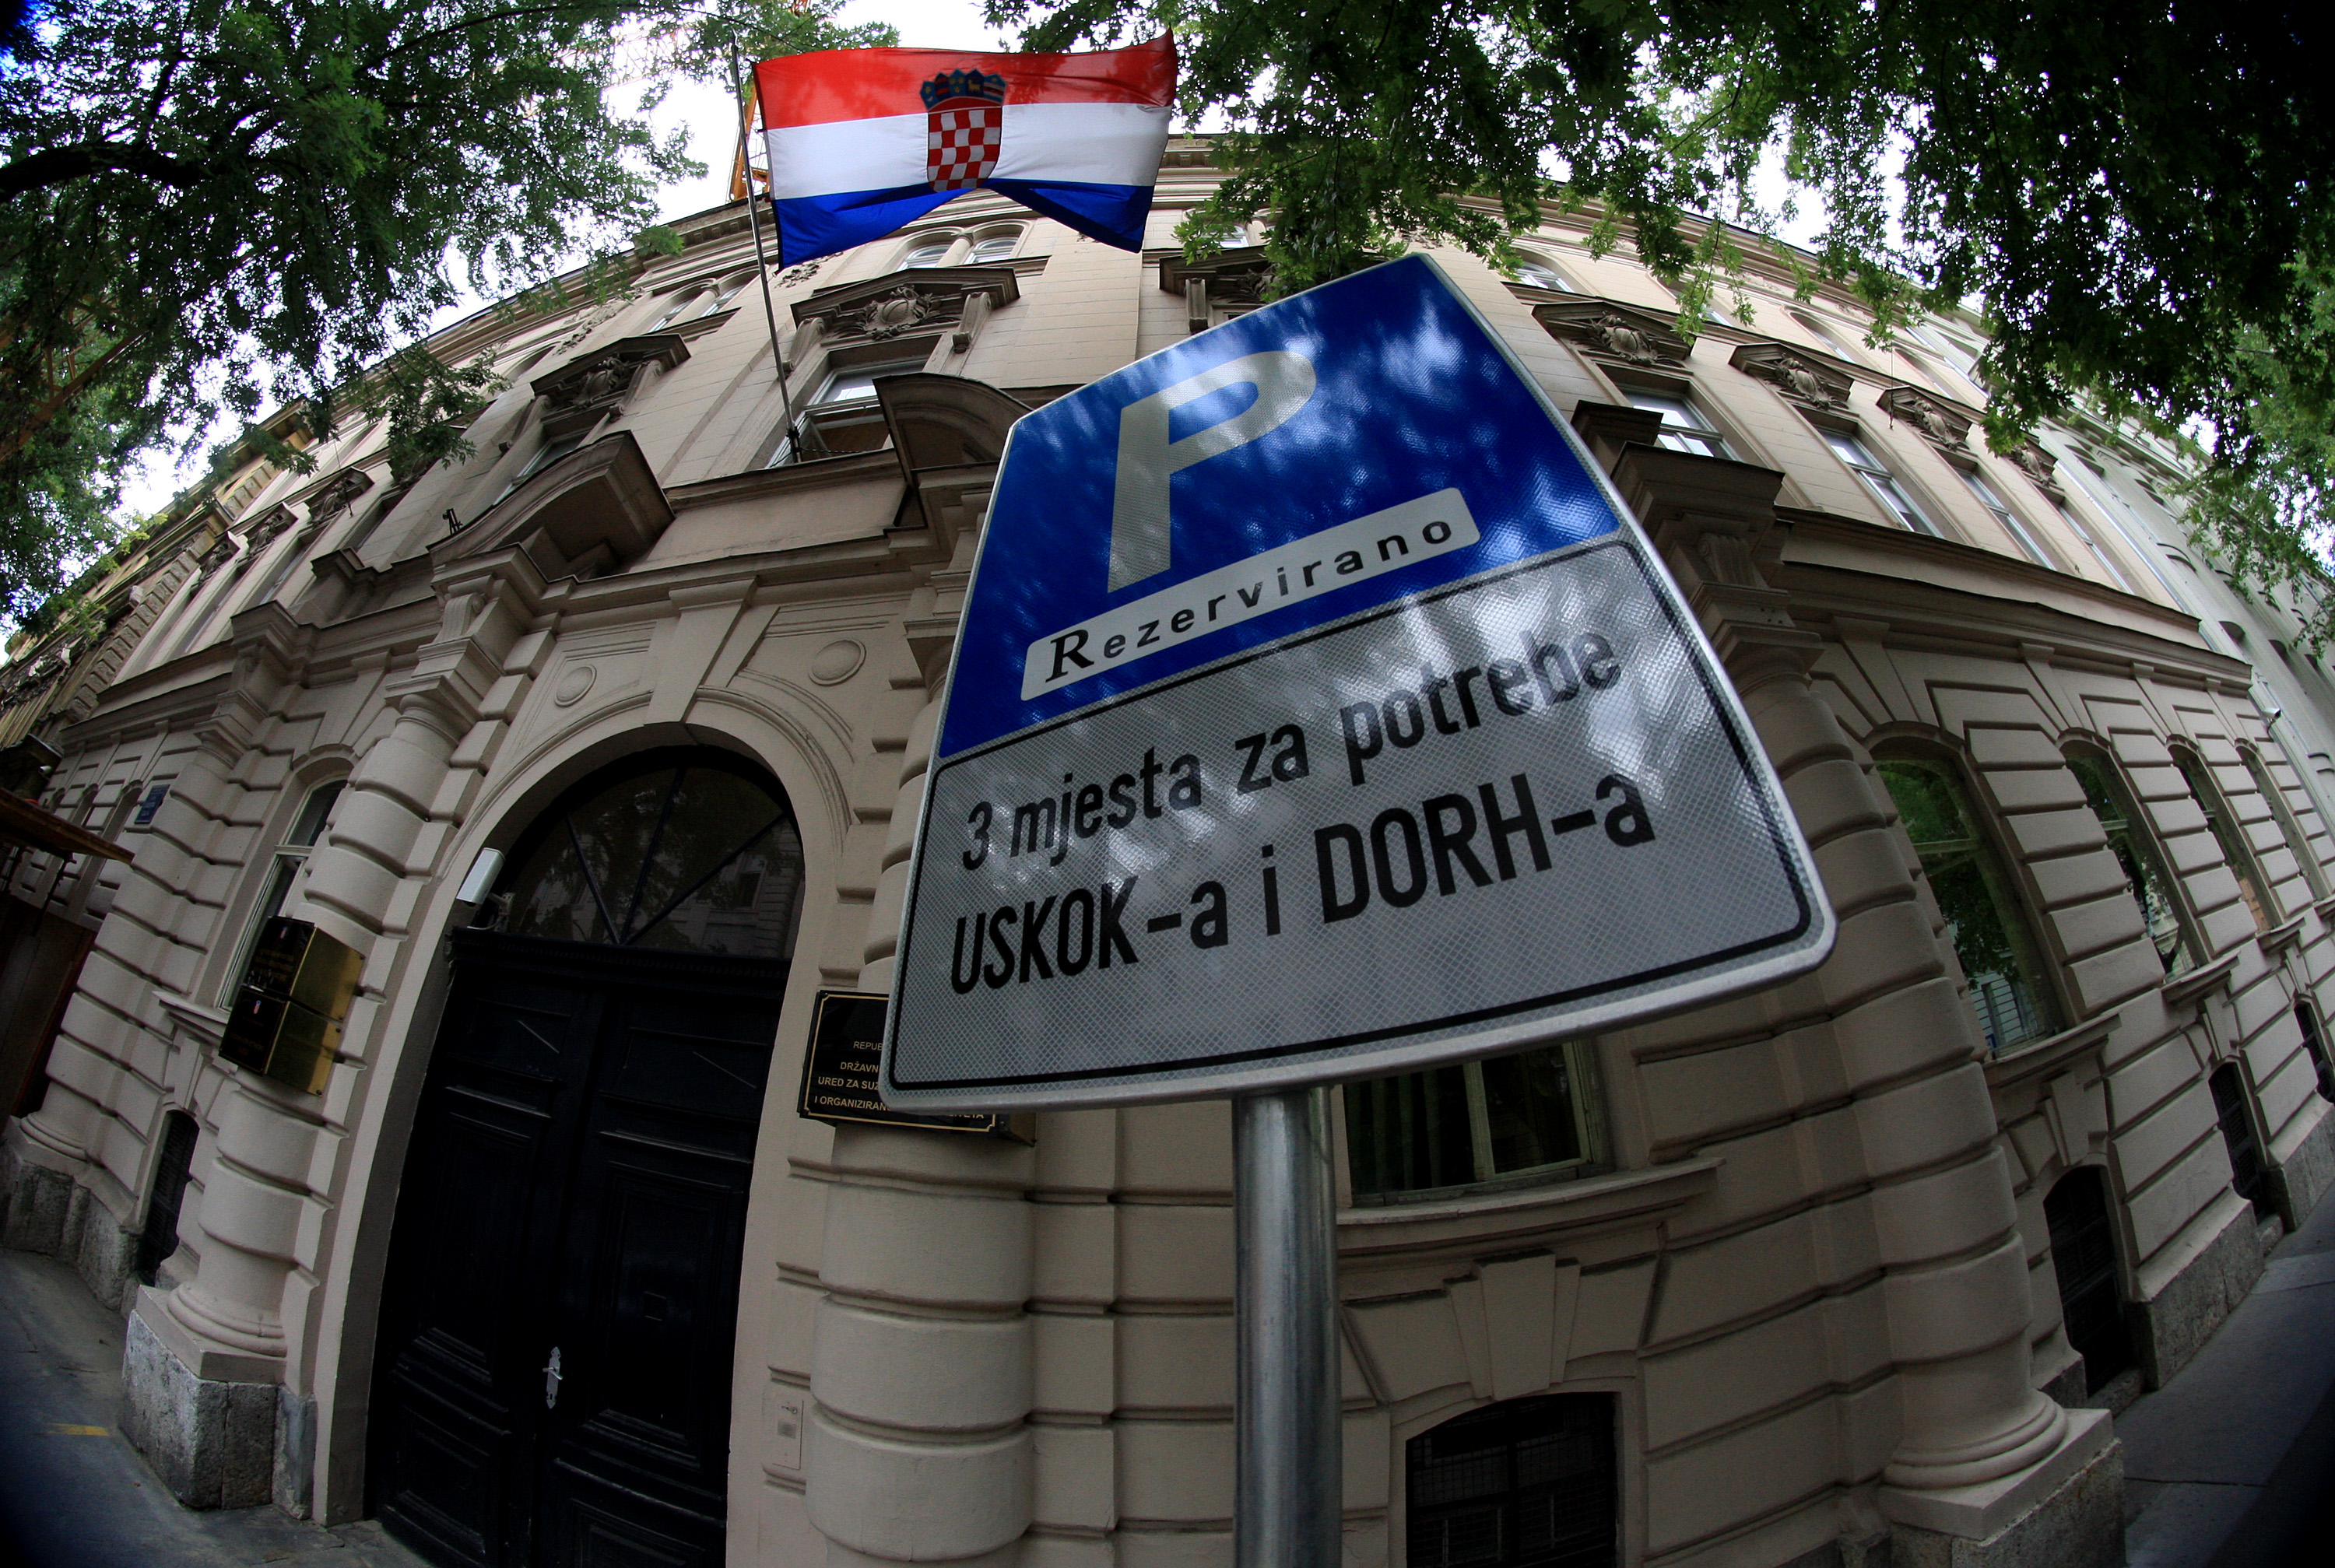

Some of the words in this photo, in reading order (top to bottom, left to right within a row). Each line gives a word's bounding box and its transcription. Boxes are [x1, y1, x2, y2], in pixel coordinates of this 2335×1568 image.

[1107, 350, 1317, 593] P
[1045, 520, 1452, 682] Rezervirano
[962, 801, 991, 871] 3
[1010, 747, 1204, 867] mjesta
[1232, 722, 1311, 796] za
[1340, 627, 1620, 786] potrebe
[950, 875, 1229, 995] USKOK-a
[1262, 844, 1283, 936] i
[1314, 772, 1658, 924] DORH-a
[818, 1076, 844, 1087] URED
[845, 1079, 859, 1089] ZA
